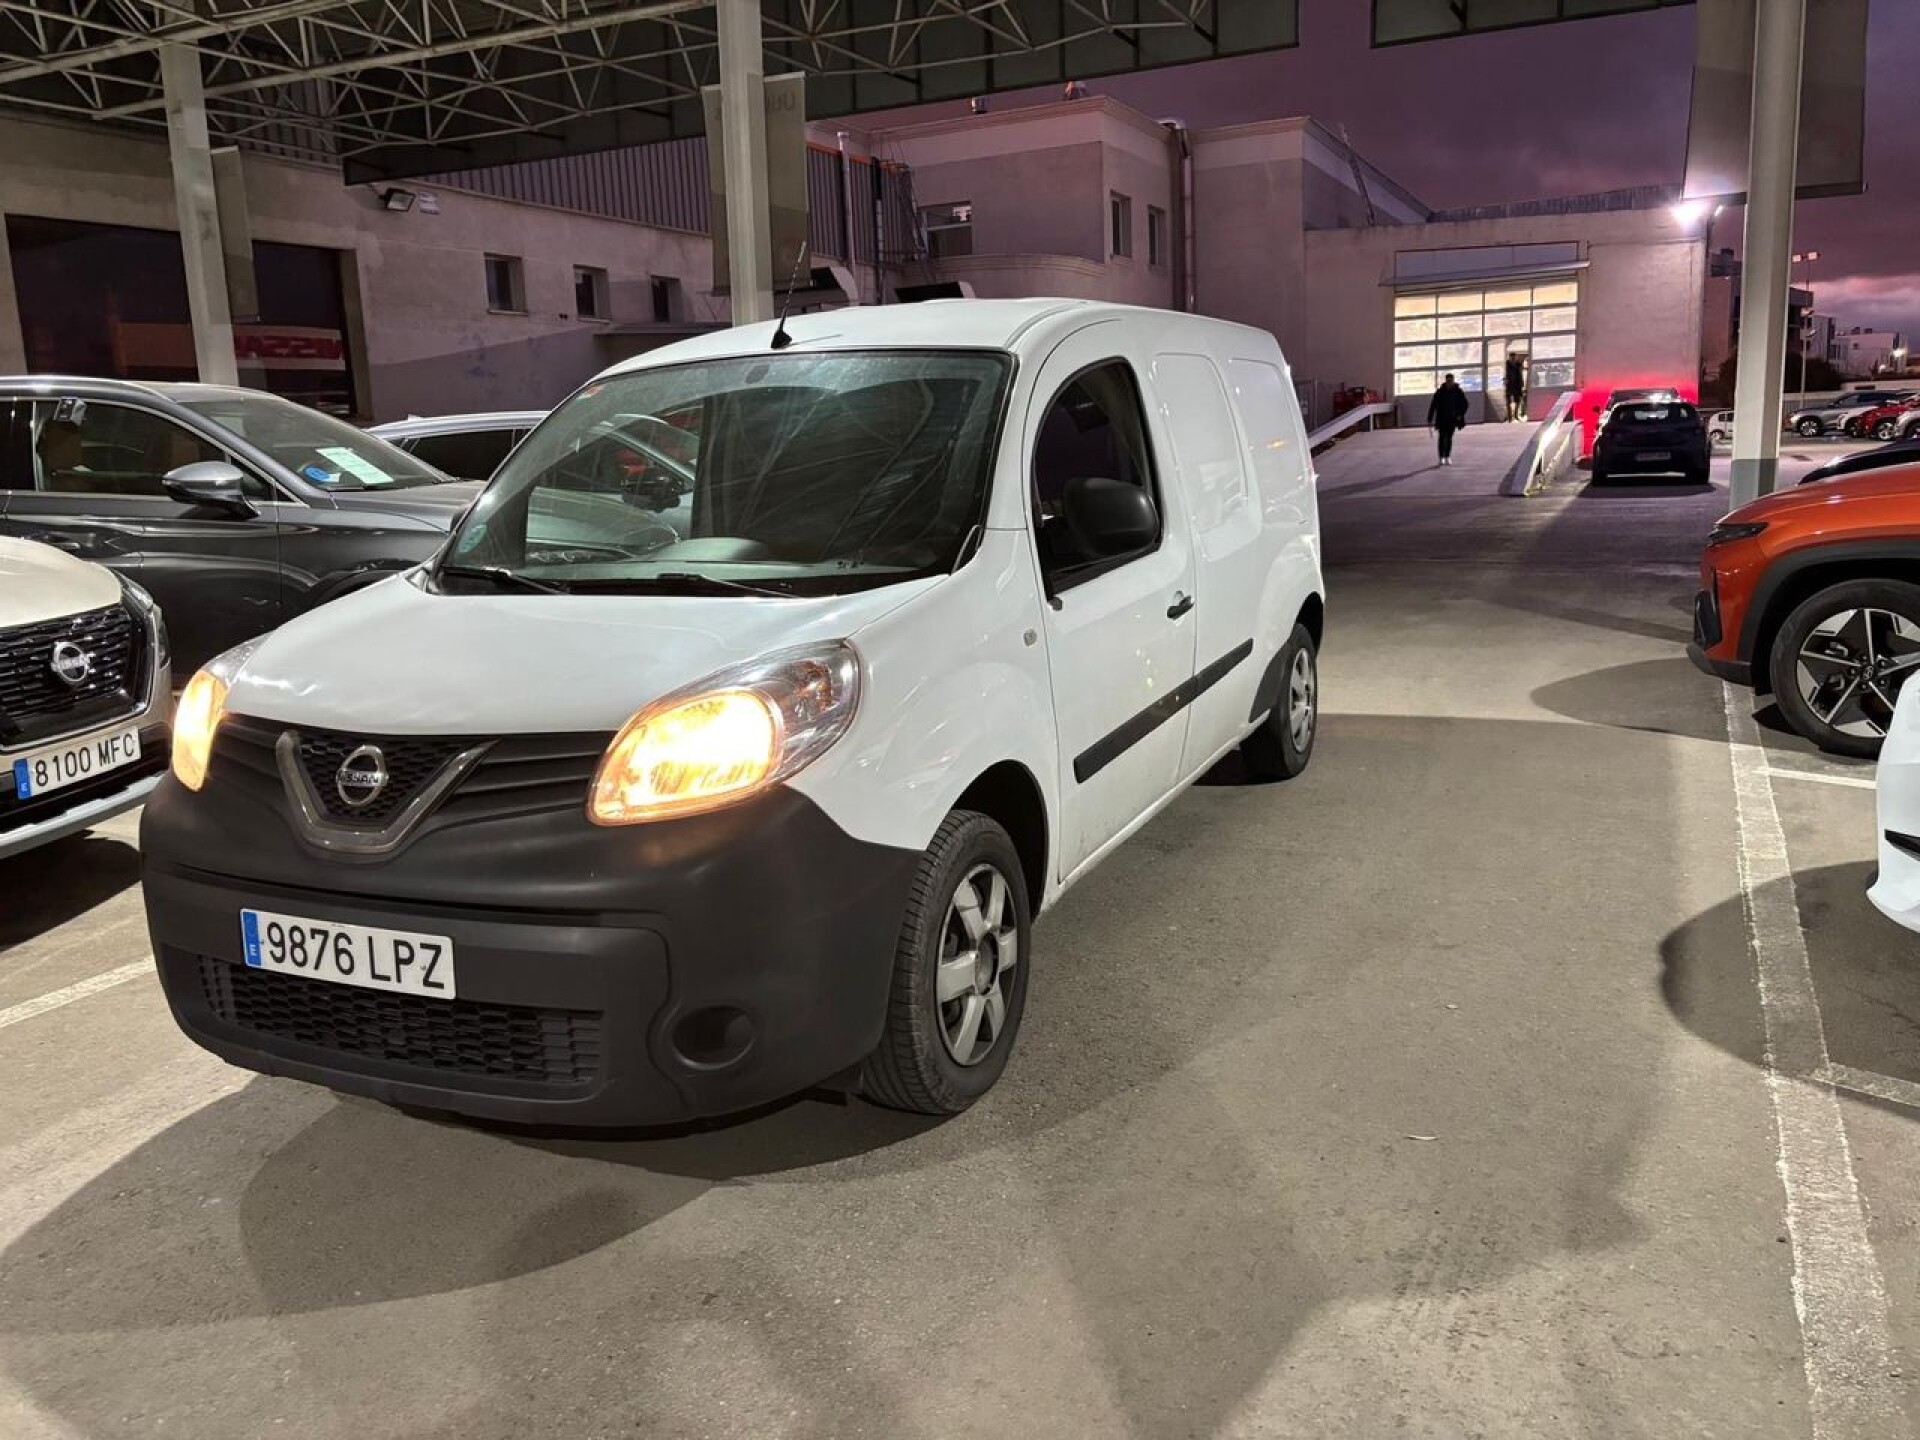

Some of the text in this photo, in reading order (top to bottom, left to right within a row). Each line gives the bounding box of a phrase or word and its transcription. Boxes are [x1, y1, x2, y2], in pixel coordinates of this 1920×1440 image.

[36, 747, 91, 786] 8100
[98, 734, 134, 767] MFC
[267, 922, 354, 975] 9876
[368, 936, 445, 990] LPZ
